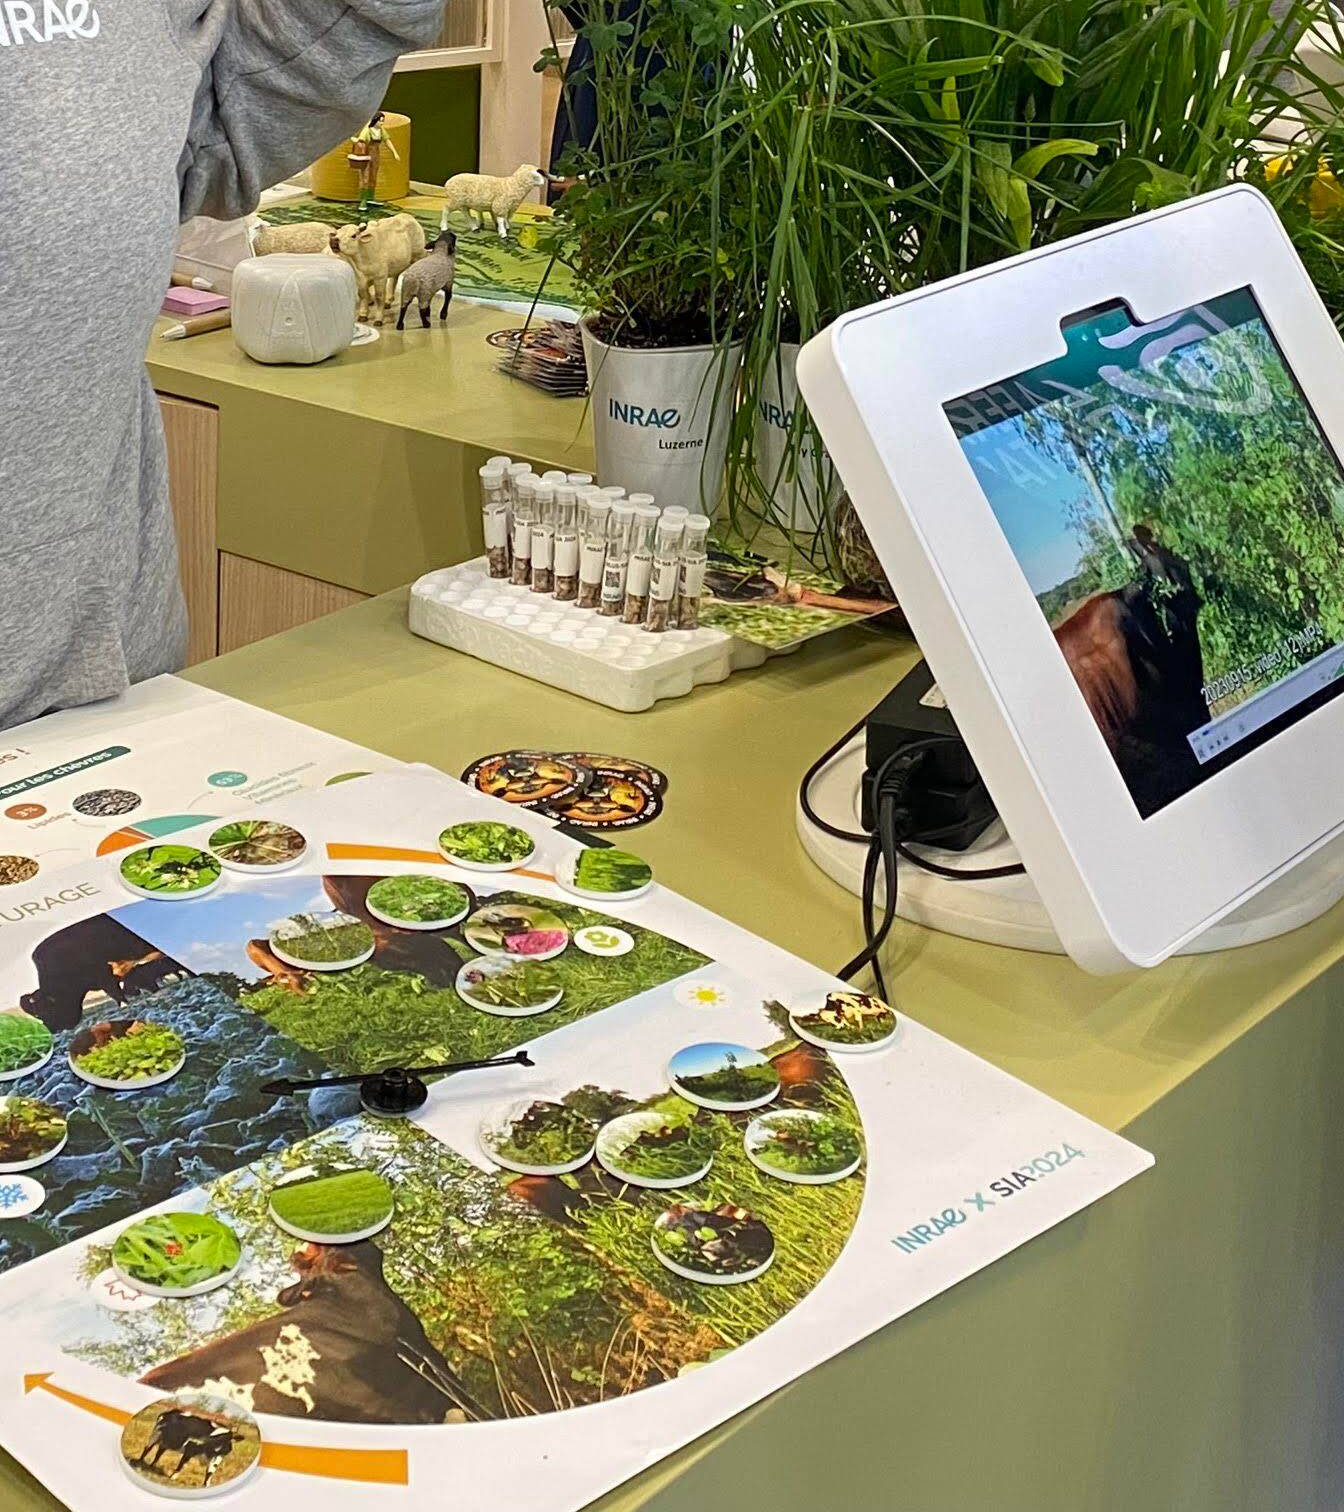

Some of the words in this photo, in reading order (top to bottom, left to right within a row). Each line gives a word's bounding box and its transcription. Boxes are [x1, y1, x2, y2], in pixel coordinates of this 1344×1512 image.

[658, 438, 703, 449] Luzerne
[25, 773, 54, 786] les
[52, 752, 112, 776] chèvres
